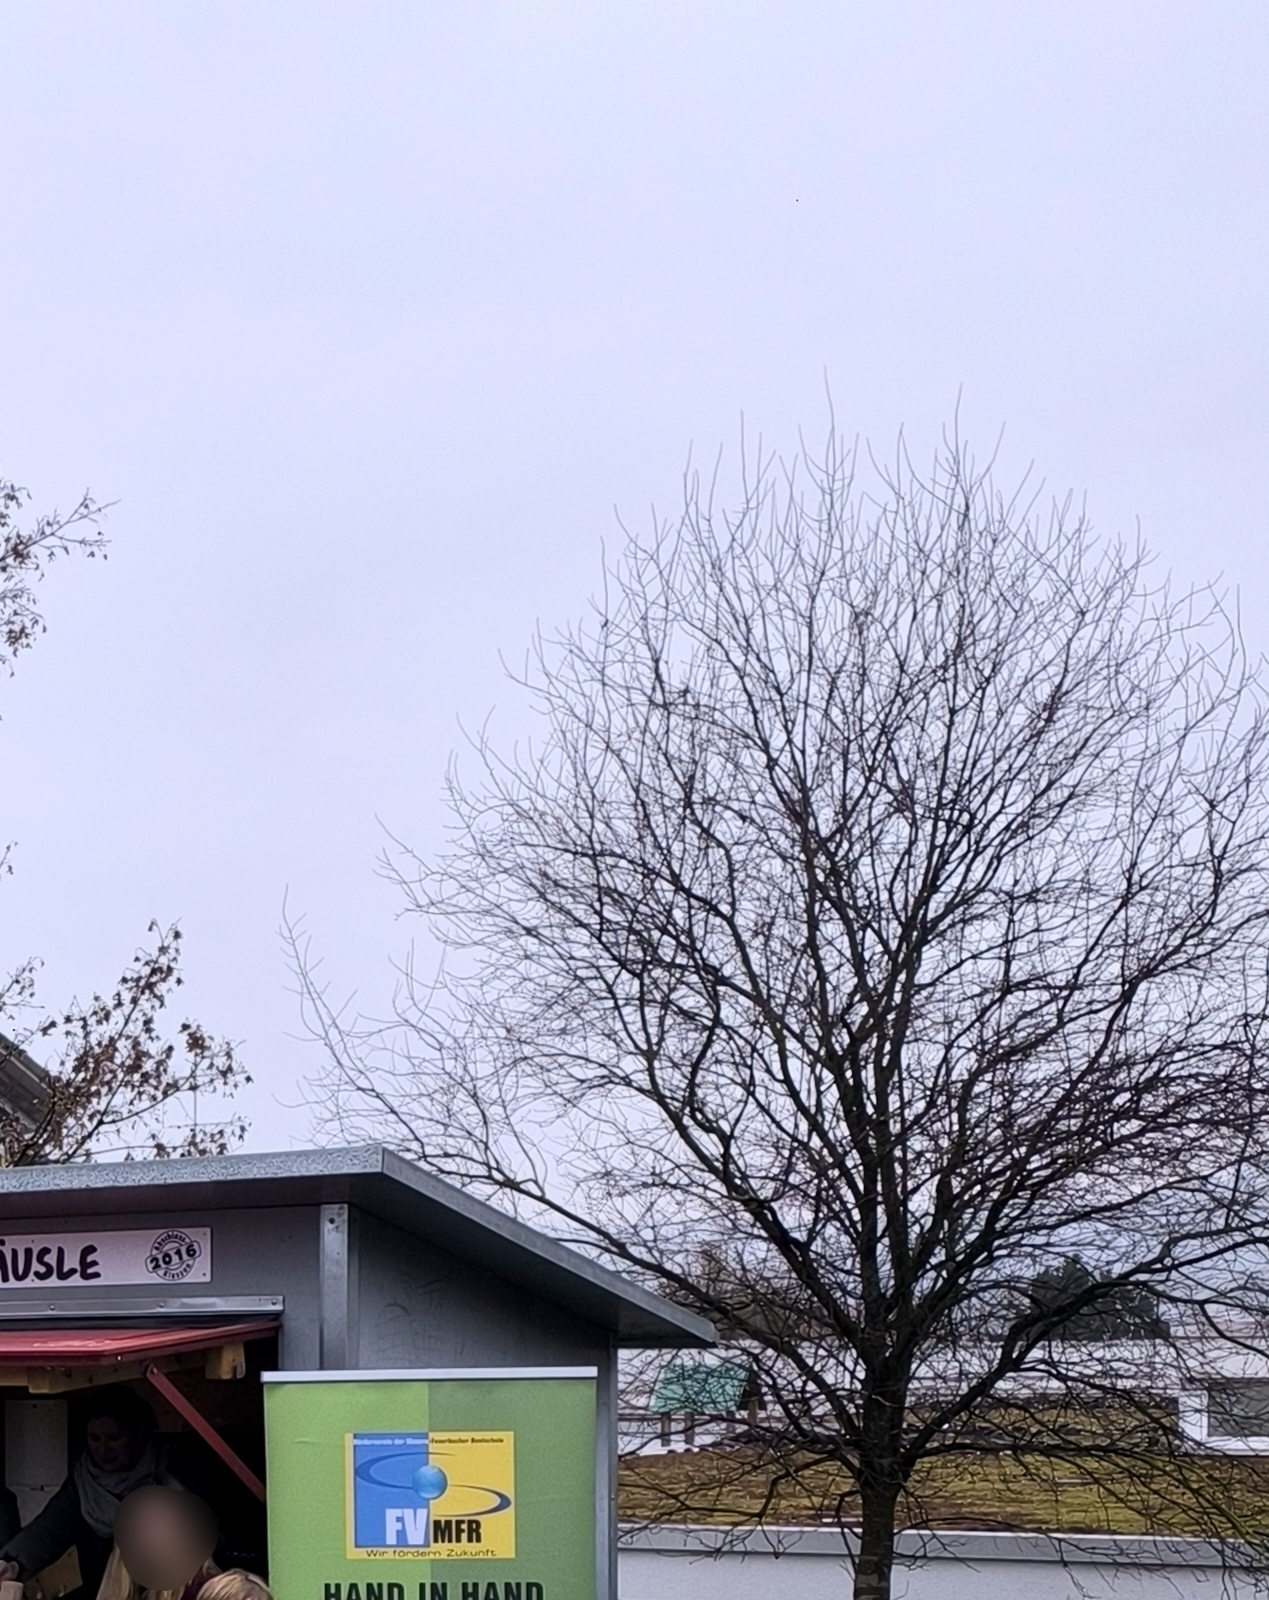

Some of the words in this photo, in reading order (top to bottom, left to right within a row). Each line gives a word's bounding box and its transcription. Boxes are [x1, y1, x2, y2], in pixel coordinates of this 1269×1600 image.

[149, 1243, 197, 1271] 2016
[385, 1508, 428, 1545] FV
[432, 1519, 482, 1544] MFR
[365, 1549, 389, 1558] Wir
[393, 1549, 442, 1558] fördern
[446, 1548, 497, 1557] Zukunft
